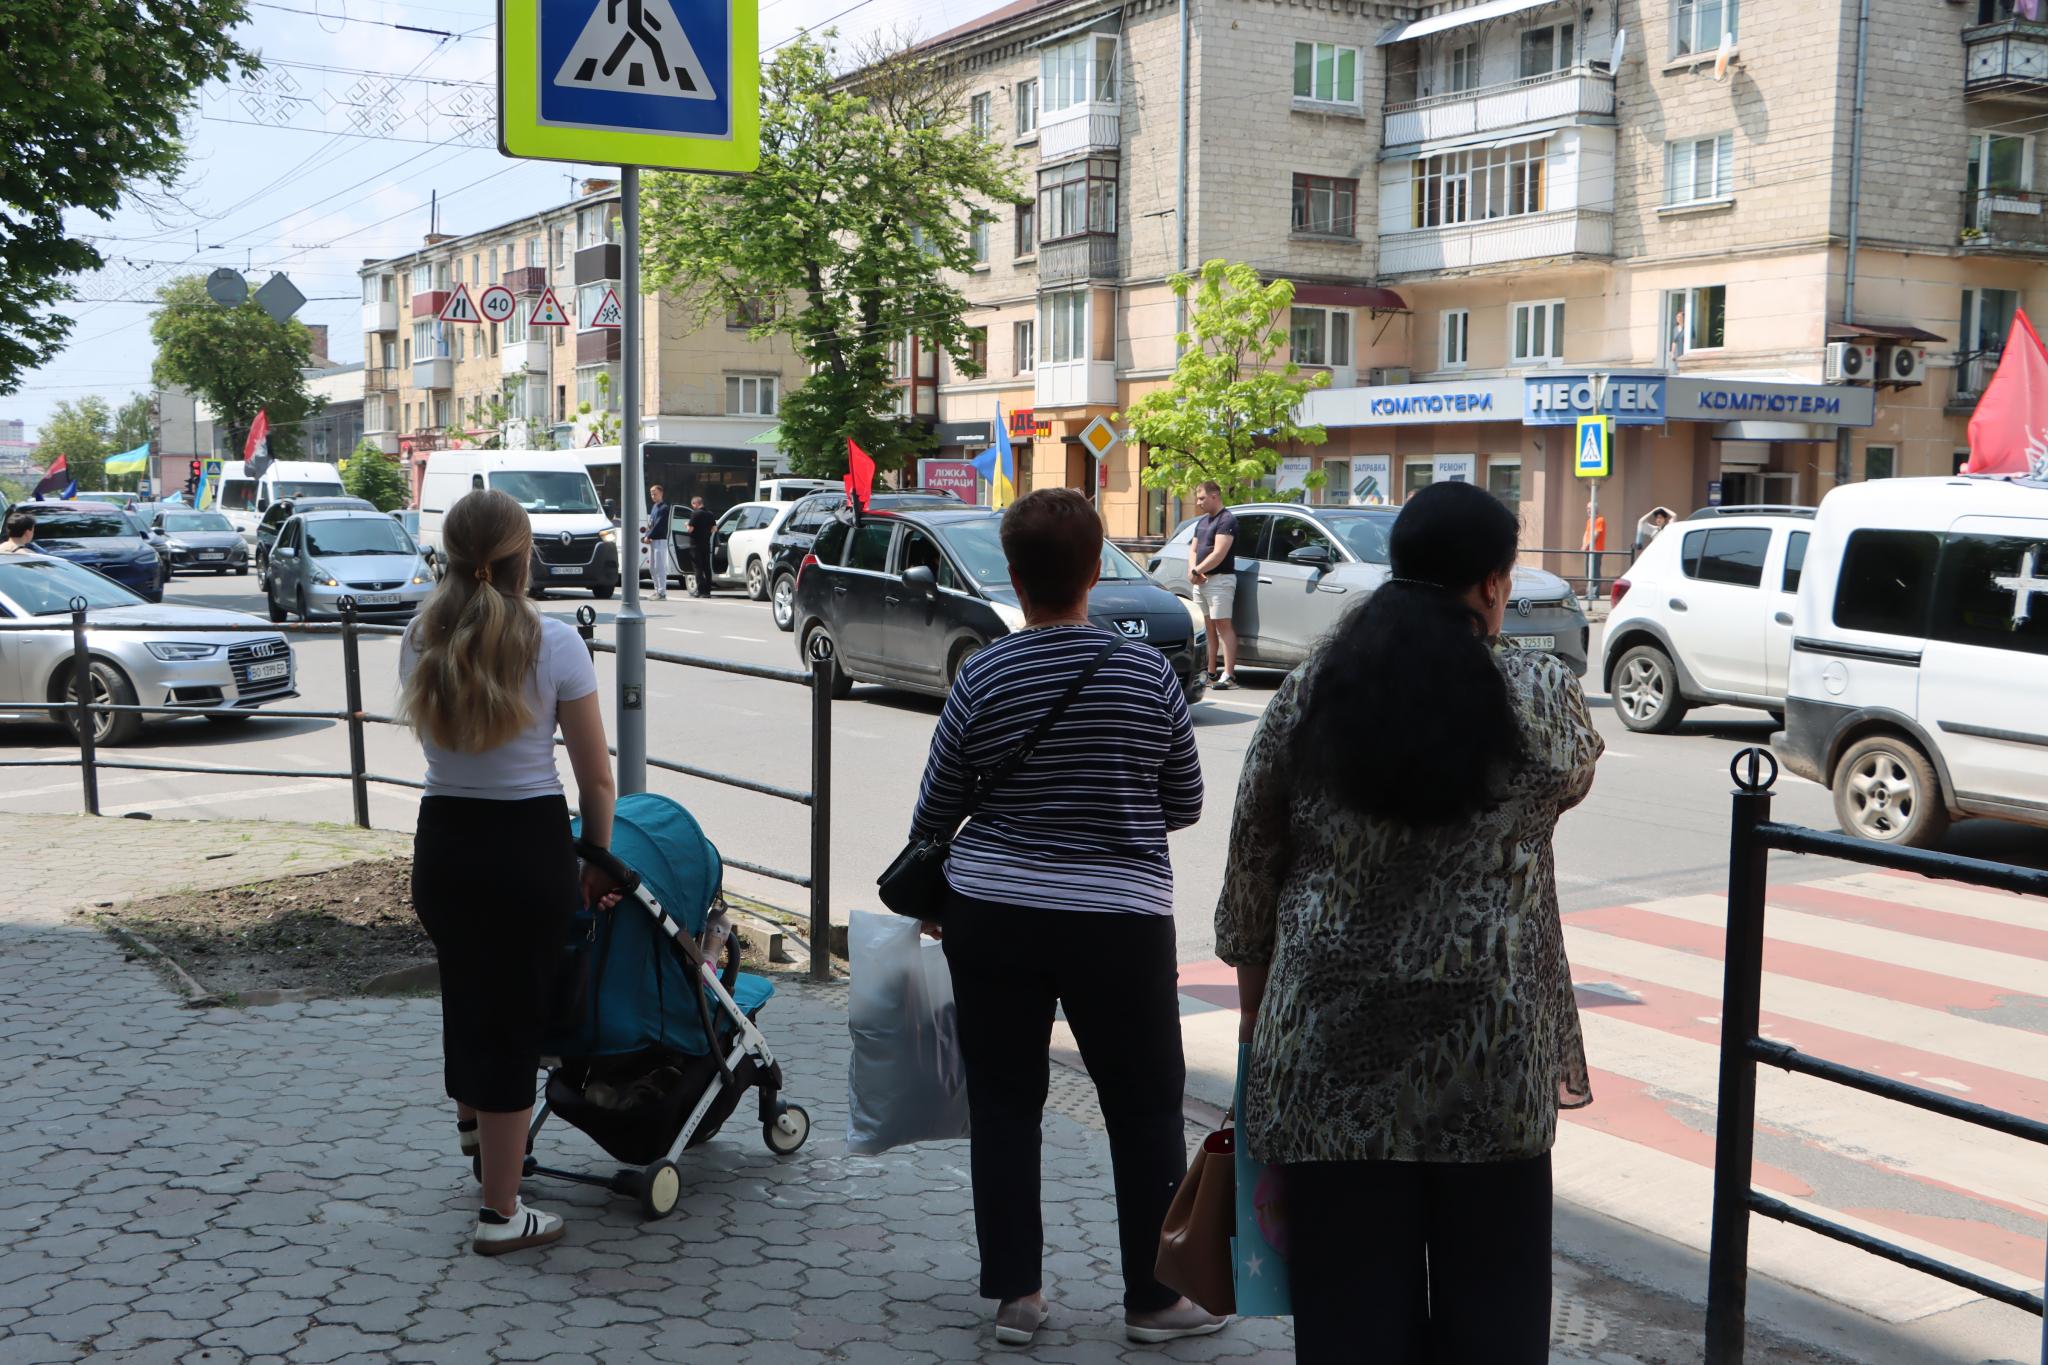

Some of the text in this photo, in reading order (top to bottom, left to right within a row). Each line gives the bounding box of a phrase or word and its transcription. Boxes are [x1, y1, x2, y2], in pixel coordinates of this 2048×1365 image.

[487, 297, 509, 312] 40
[1354, 463, 1387, 473] ЗАПРАВКА
[1440, 463, 1467, 471] РЕМОНТ
[934, 469, 967, 477] ЛІЖКА
[928, 478, 974, 488] МАТРАЦИ
